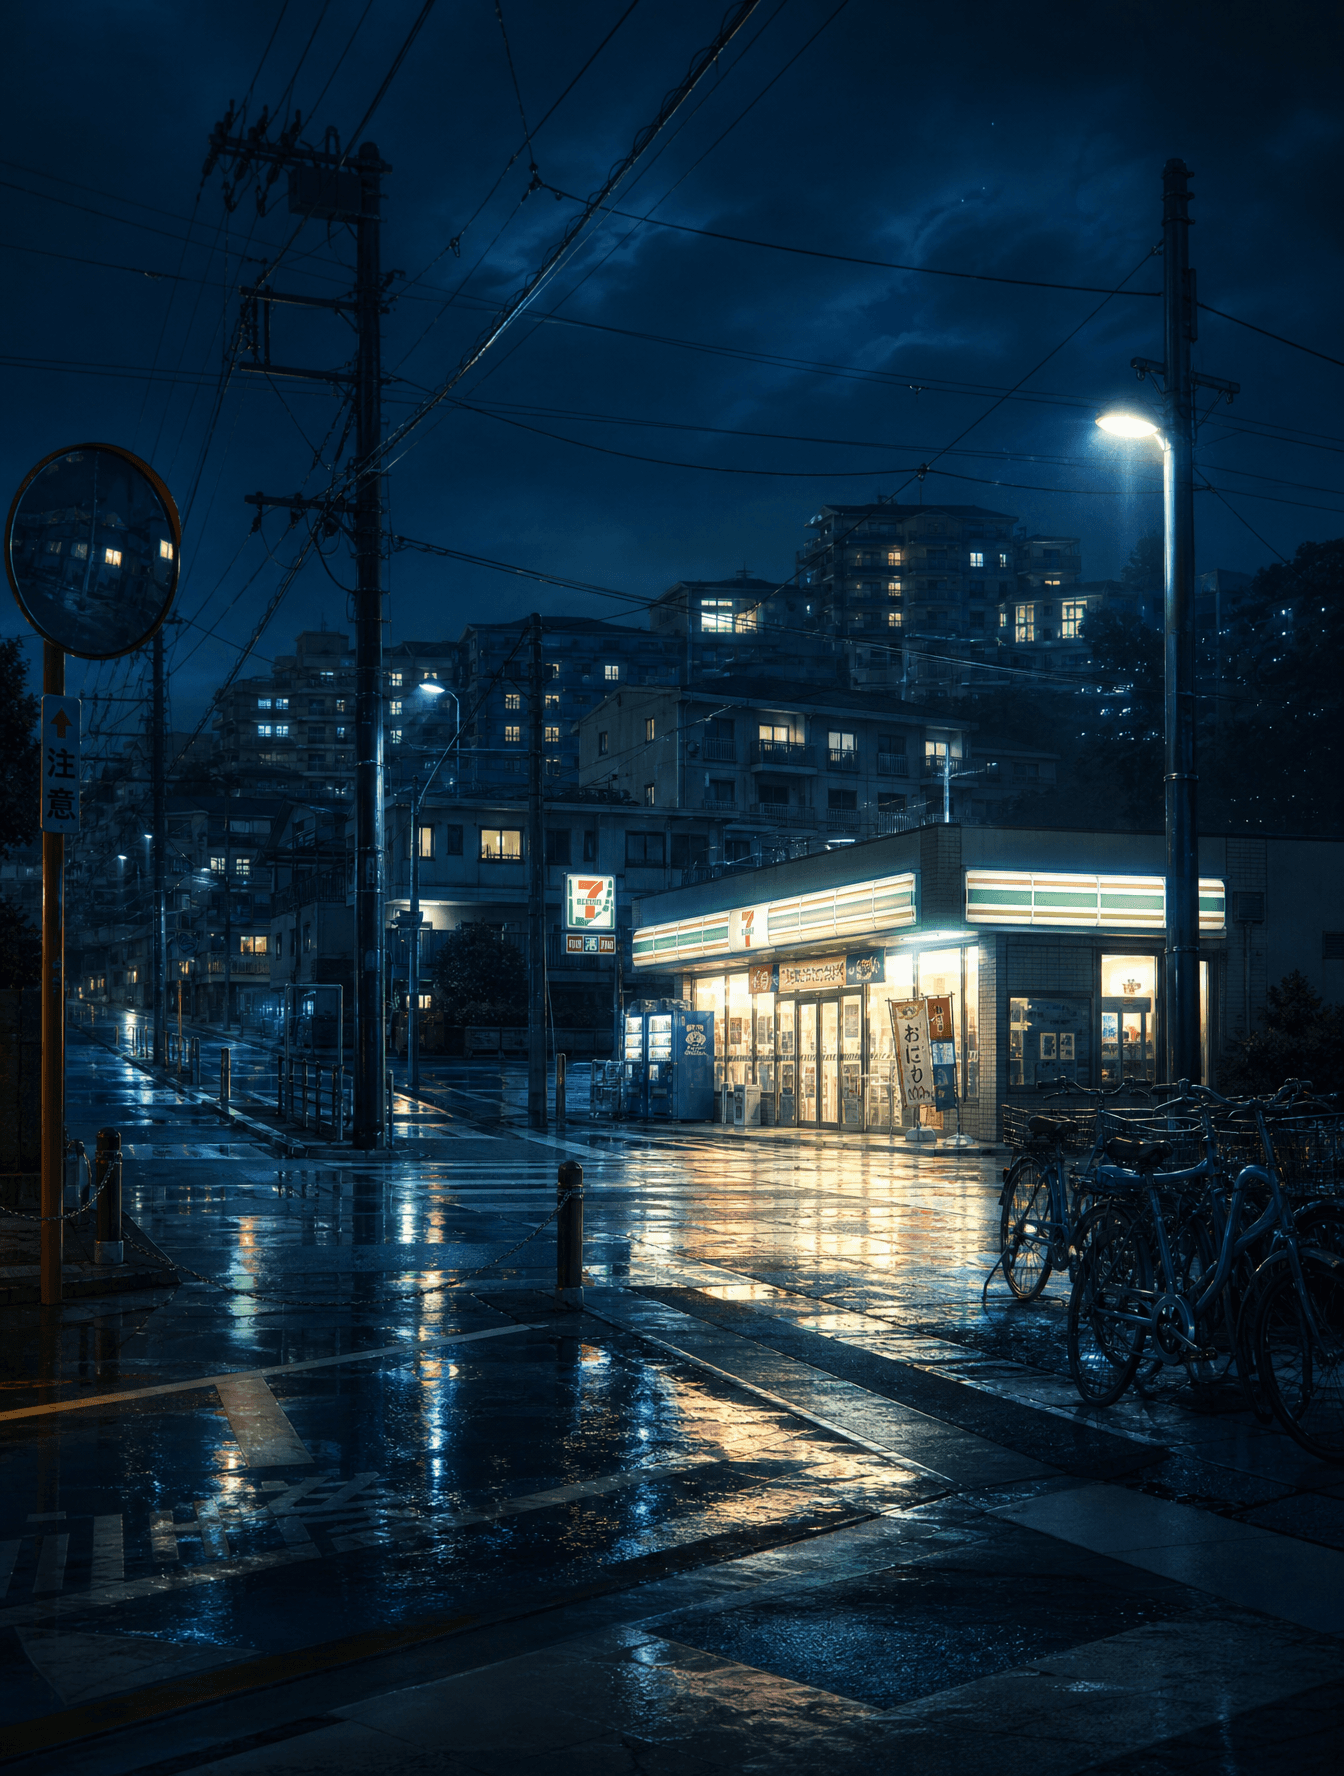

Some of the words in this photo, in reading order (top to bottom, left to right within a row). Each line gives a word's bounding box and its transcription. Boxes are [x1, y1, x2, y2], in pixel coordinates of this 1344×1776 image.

[47, 748, 76, 820] 注意
[578, 880, 603, 918] 7
[741, 910, 754, 947] 7
